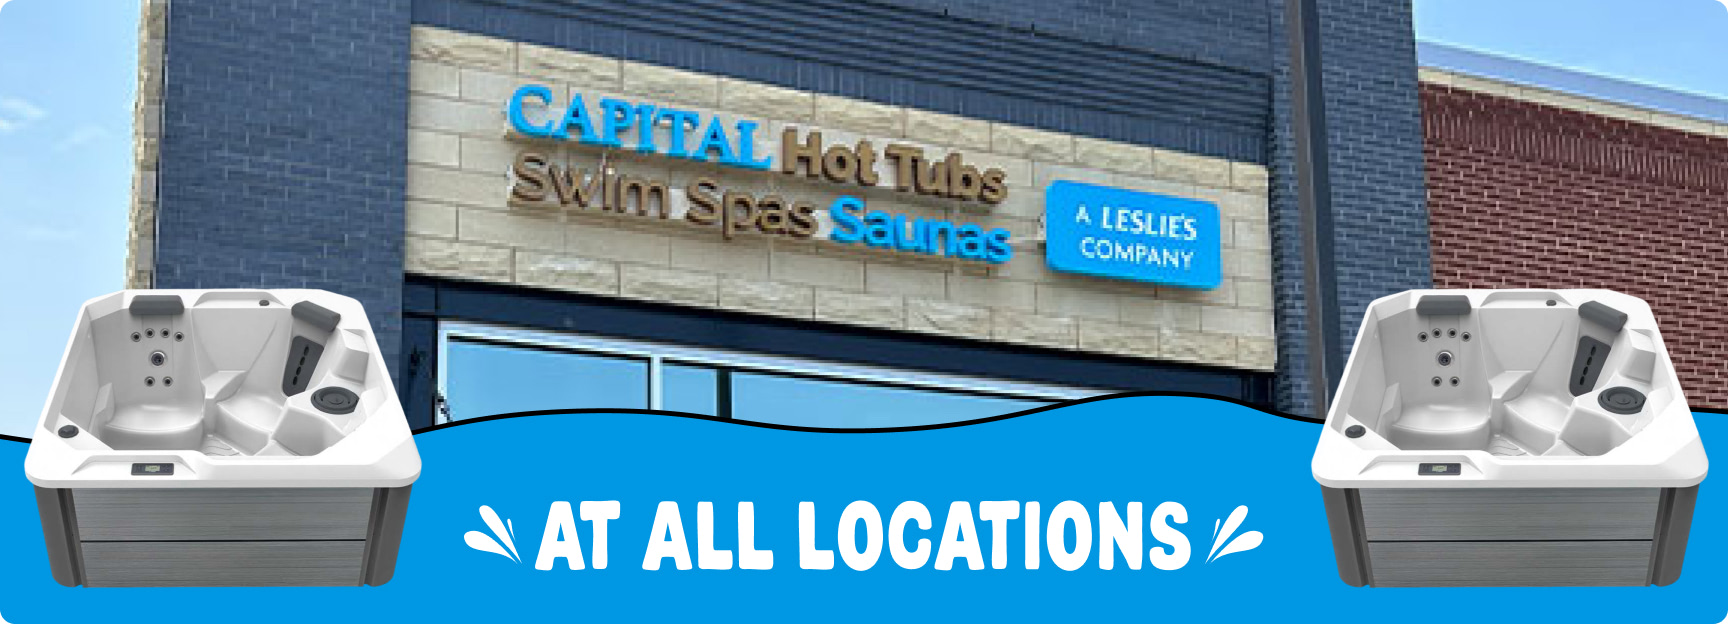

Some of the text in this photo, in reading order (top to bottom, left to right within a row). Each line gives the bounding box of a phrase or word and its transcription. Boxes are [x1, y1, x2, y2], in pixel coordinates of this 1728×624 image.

[509, 84, 1008, 204] CAPITAL Hot Tubs
[511, 150, 1013, 264] Swim Spas Saunas
[1076, 204, 1197, 241] A LESLIE'S
[1081, 237, 1194, 270] COMPANY
